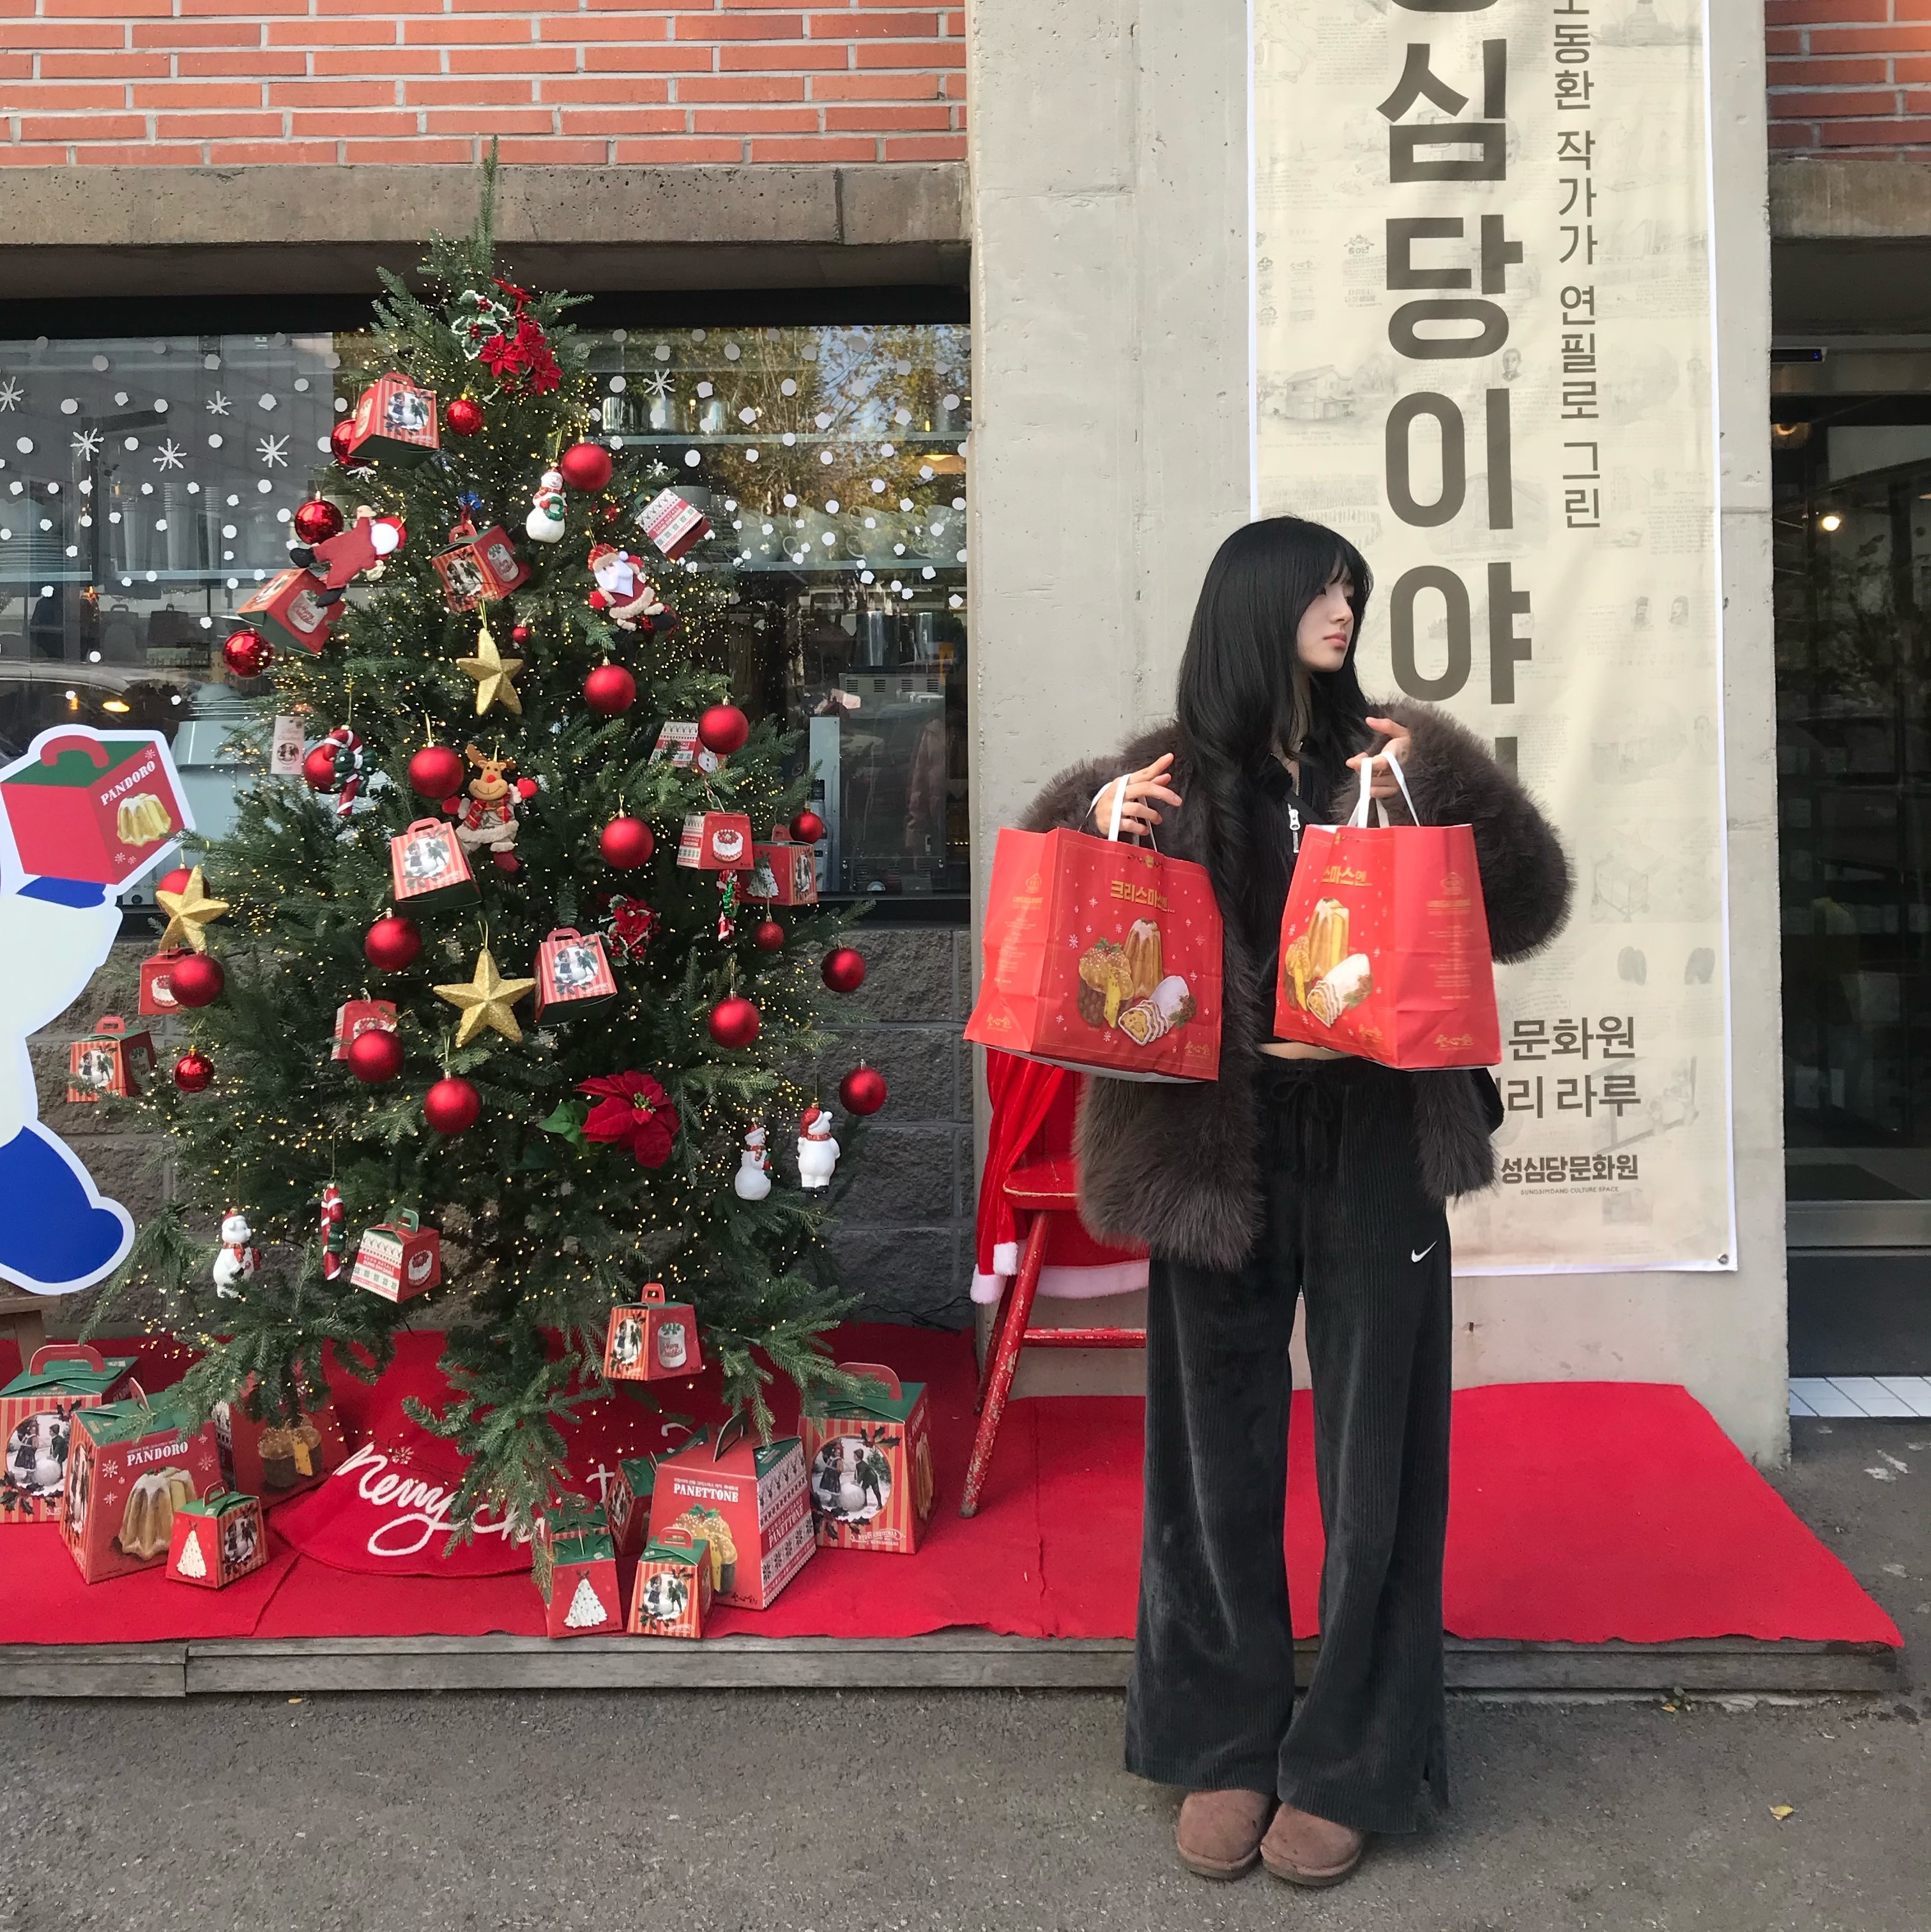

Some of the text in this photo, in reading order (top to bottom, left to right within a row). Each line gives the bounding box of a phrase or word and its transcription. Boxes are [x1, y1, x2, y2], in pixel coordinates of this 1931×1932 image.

[1557, 130, 1598, 265] 작가가
[1561, 285, 1599, 419] 연필로
[1376, 0, 1532, 784] 심당이야
[1562, 441, 1601, 528] 그린
[100, 761, 156, 806] PANDORO
[1508, 1016, 1635, 1061] 문화원
[1557, 1075, 1641, 1117] 라루
[1501, 1154, 1638, 1184] 성심당문화원
[127, 1441, 188, 1466] PANDORO
[673, 1483, 739, 1503] PANETTONE
[768, 1503, 804, 1549] PANETTONE
